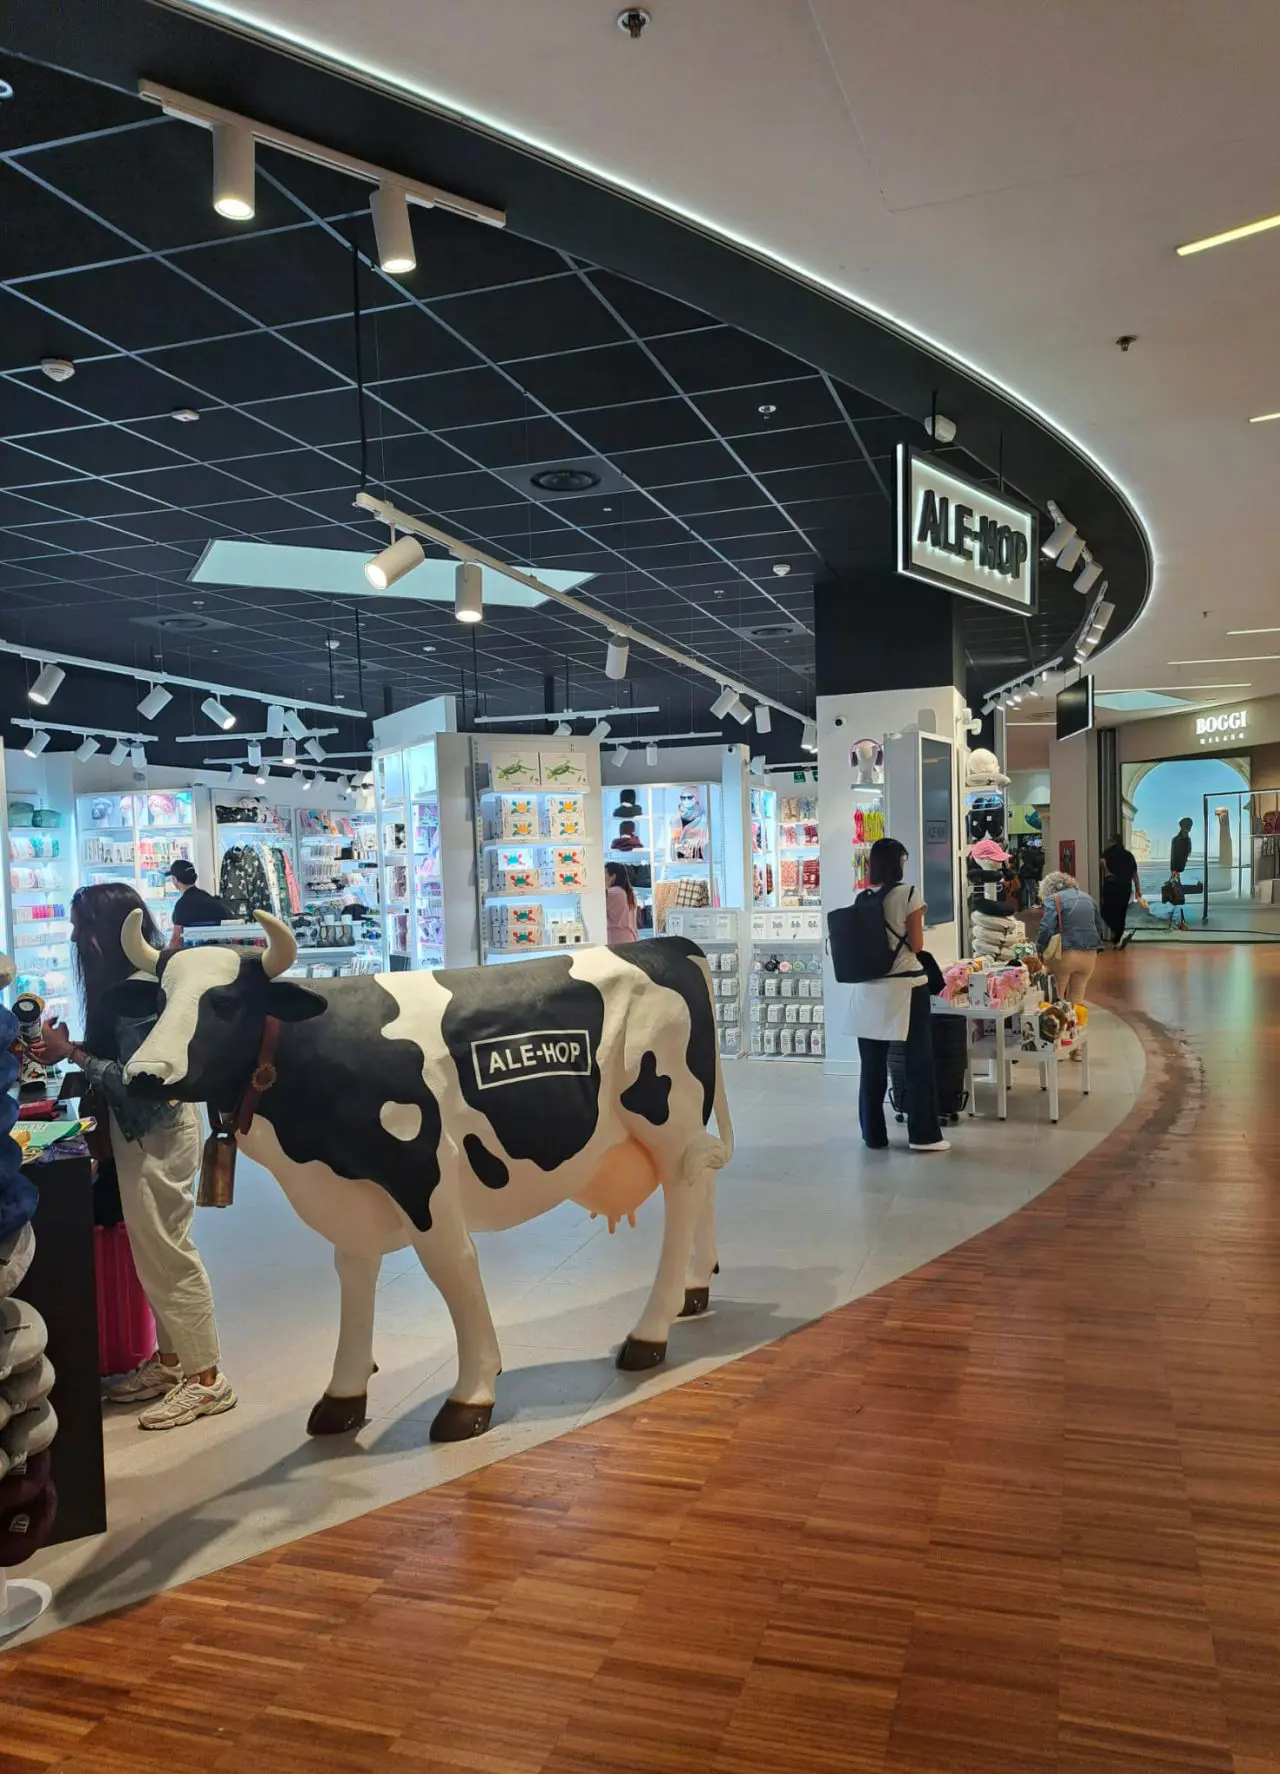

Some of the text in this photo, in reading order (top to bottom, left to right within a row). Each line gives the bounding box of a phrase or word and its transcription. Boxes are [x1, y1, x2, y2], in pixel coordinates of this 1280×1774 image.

[917, 489, 1028, 580] ALE-HOP
[1196, 710, 1248, 735] BOGGI
[489, 1042, 581, 1074] ALE-HOP
